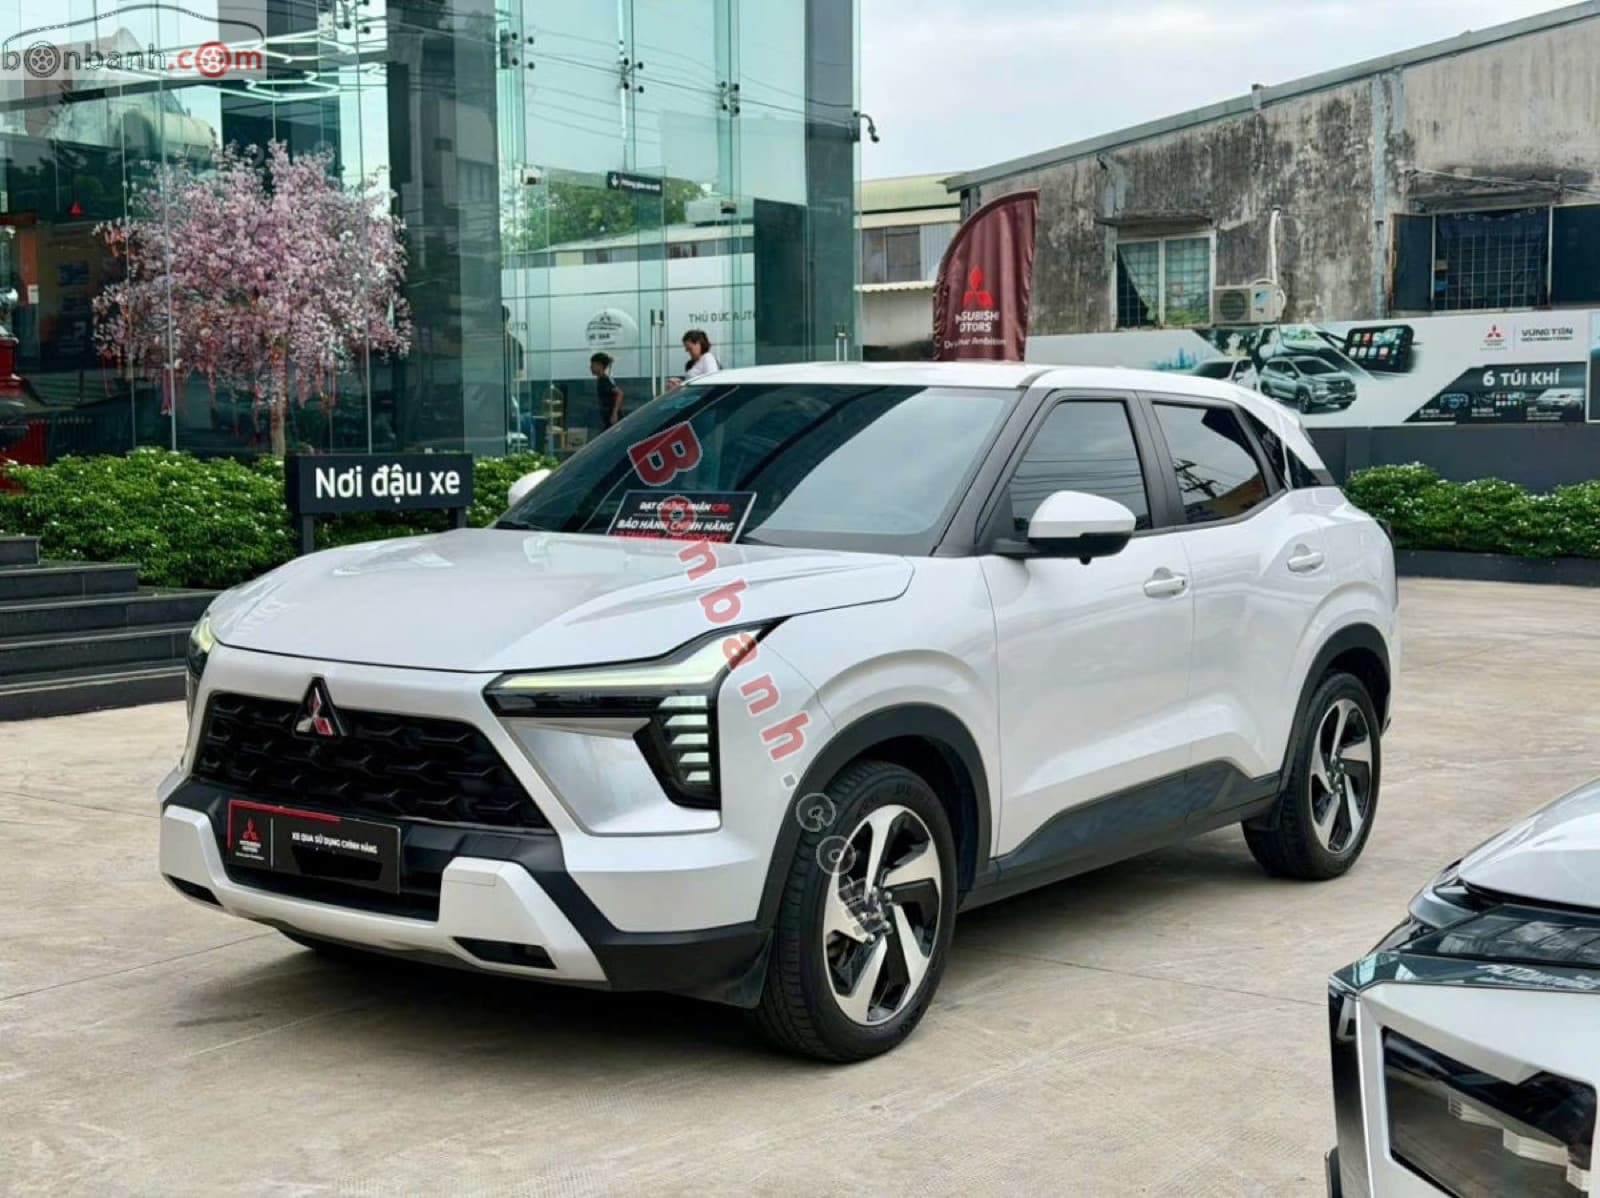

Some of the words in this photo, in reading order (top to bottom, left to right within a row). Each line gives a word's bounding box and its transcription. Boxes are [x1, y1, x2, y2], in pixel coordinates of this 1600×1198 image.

[959, 321, 992, 333] OTORS
[1482, 370, 1496, 386] 6
[1500, 369, 1527, 386] TÚI
[1531, 367, 1560, 385] KHÍ
[315, 464, 363, 499] Nơi
[371, 462, 422, 504] đậu
[429, 469, 461, 495] xe
